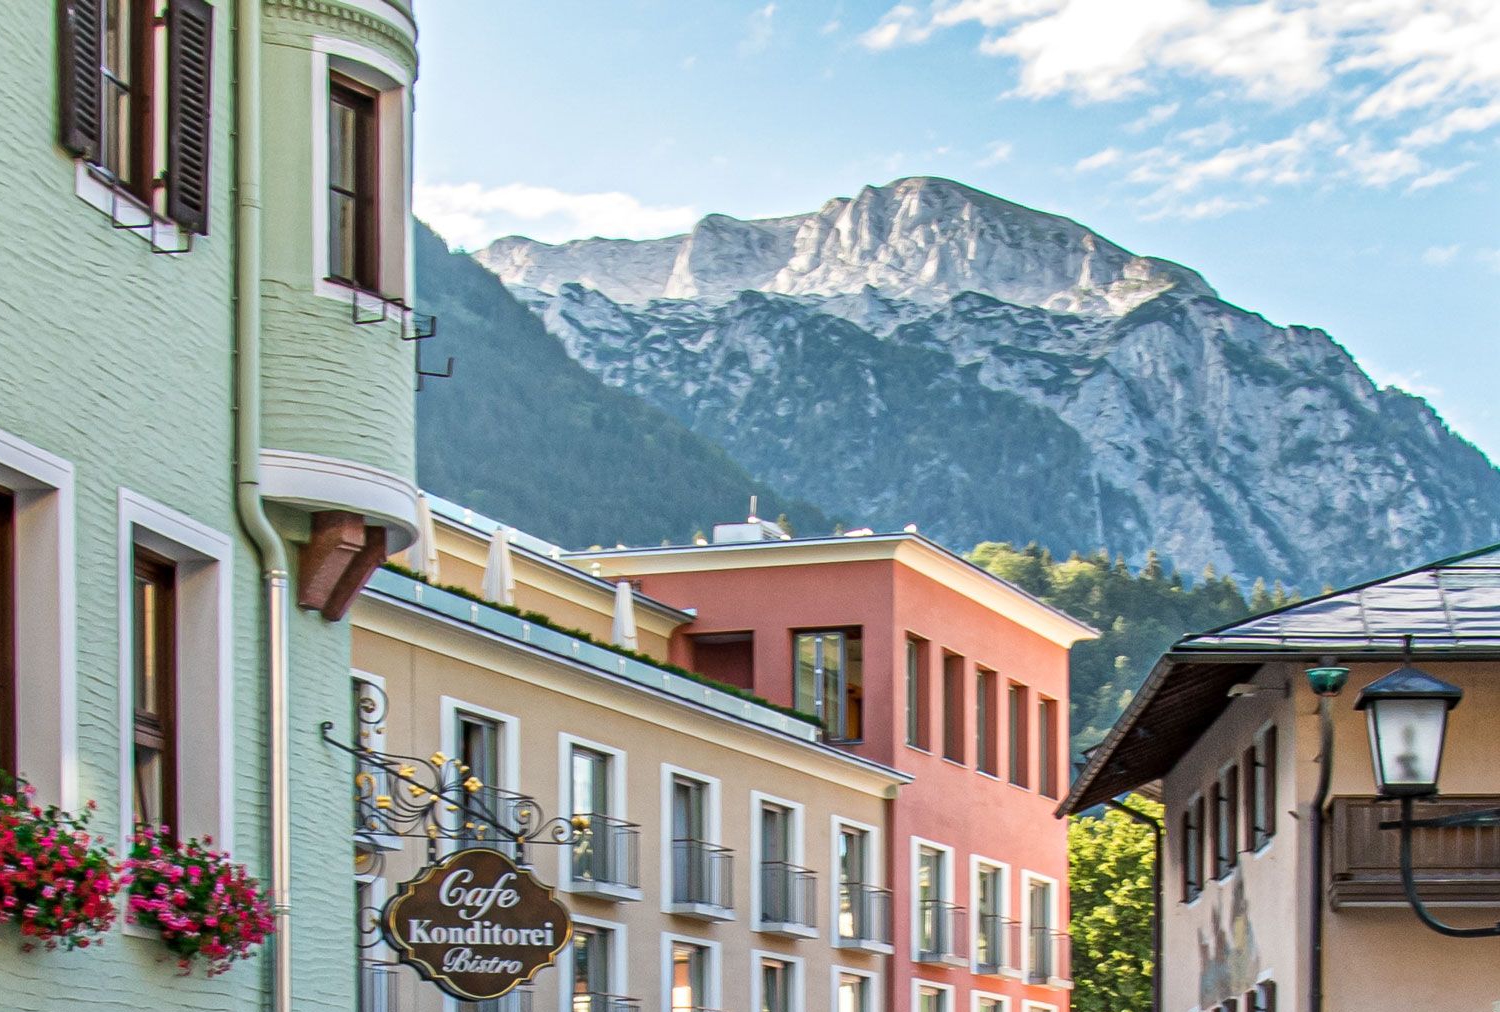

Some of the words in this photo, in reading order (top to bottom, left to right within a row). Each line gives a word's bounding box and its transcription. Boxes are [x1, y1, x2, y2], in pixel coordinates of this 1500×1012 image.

[438, 868, 521, 920] Cafe
[408, 919, 554, 946] Konditorei
[442, 946, 524, 974] Bistro
